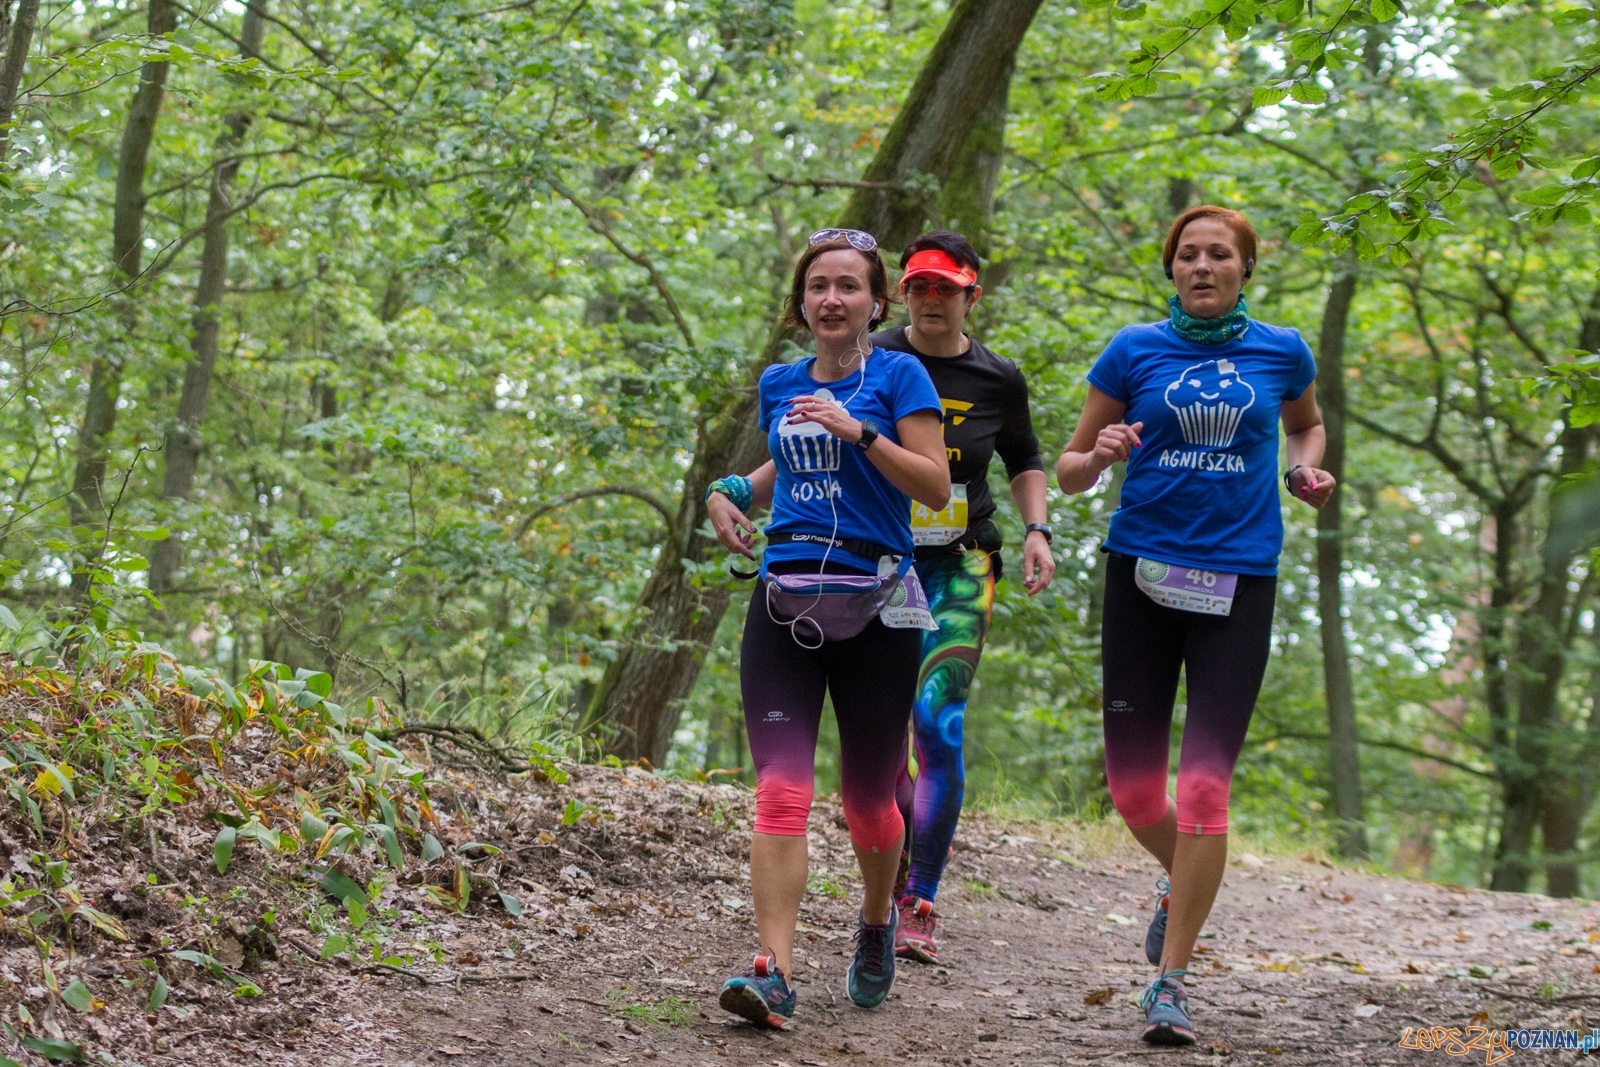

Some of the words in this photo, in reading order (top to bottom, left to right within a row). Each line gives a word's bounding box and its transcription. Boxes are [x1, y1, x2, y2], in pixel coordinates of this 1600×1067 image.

[1158, 449, 1245, 473] AGNIESZKA
[791, 479, 843, 503] GOSIA
[1186, 569, 1217, 587] 46
[1184, 584, 1215, 595] AGNIESZKA
